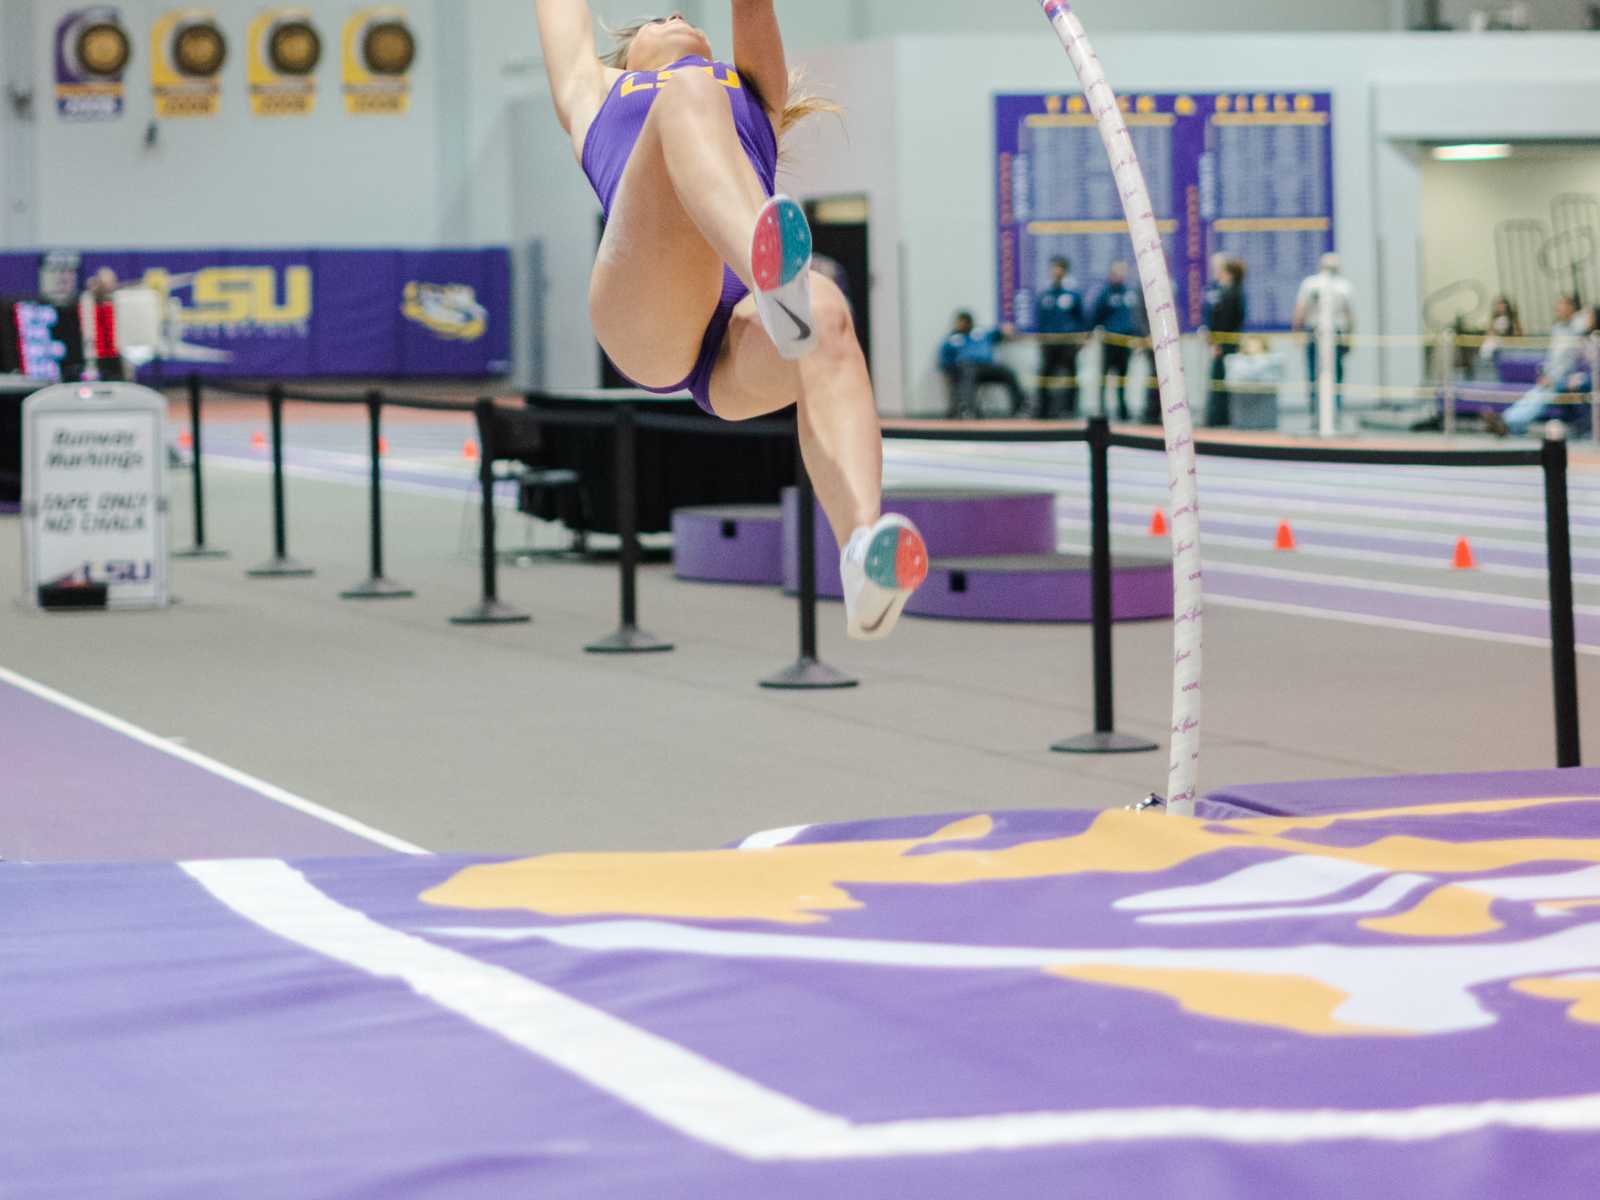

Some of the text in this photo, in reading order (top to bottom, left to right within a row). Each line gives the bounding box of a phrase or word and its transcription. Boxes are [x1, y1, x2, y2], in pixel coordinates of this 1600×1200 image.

[145, 266, 312, 324] LSU
[45, 514, 73, 532] NO
[82, 559, 152, 585] LSU
